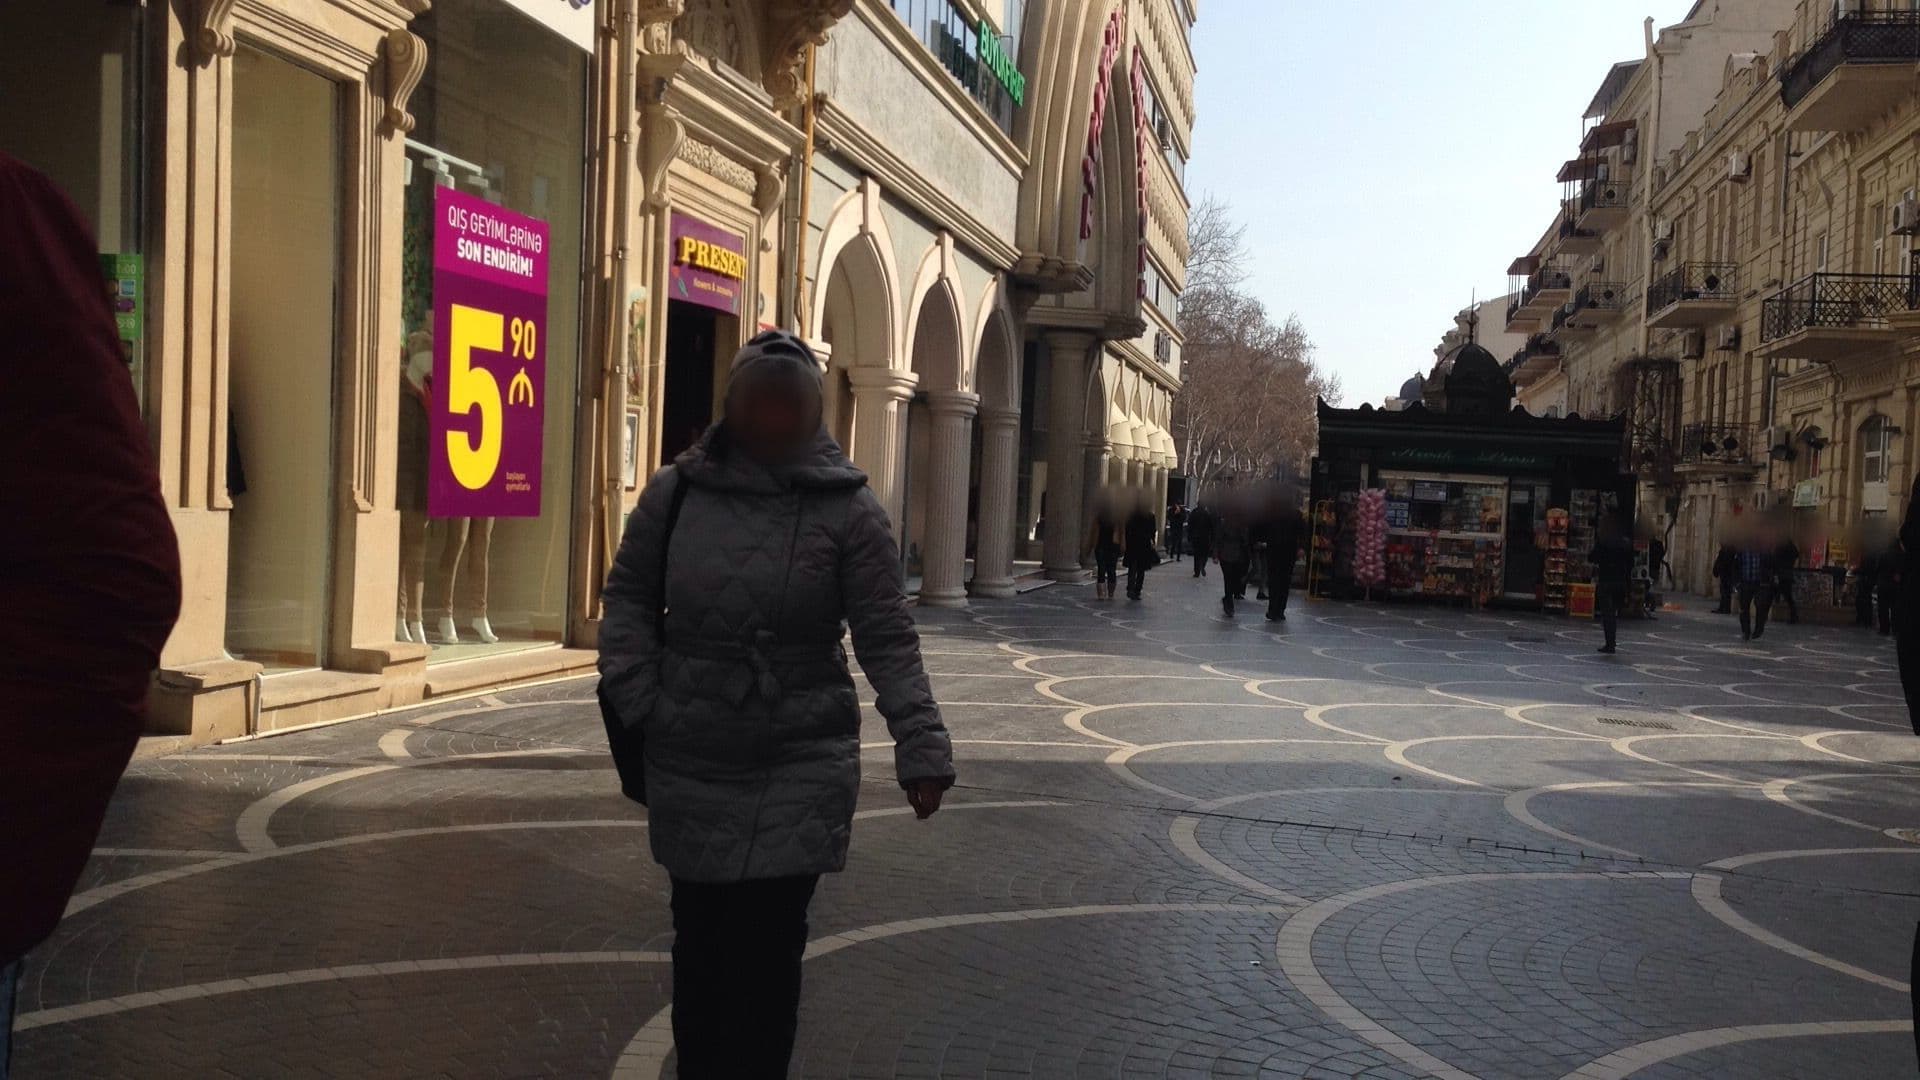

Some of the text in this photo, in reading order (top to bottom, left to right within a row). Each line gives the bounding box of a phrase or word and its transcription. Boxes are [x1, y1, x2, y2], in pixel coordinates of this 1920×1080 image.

[448, 205, 542, 254] QIŞ GEYİMLƏRİNƏ
[457, 237, 533, 278] SON ENDİRİM!
[446, 303, 537, 490] 5 90
